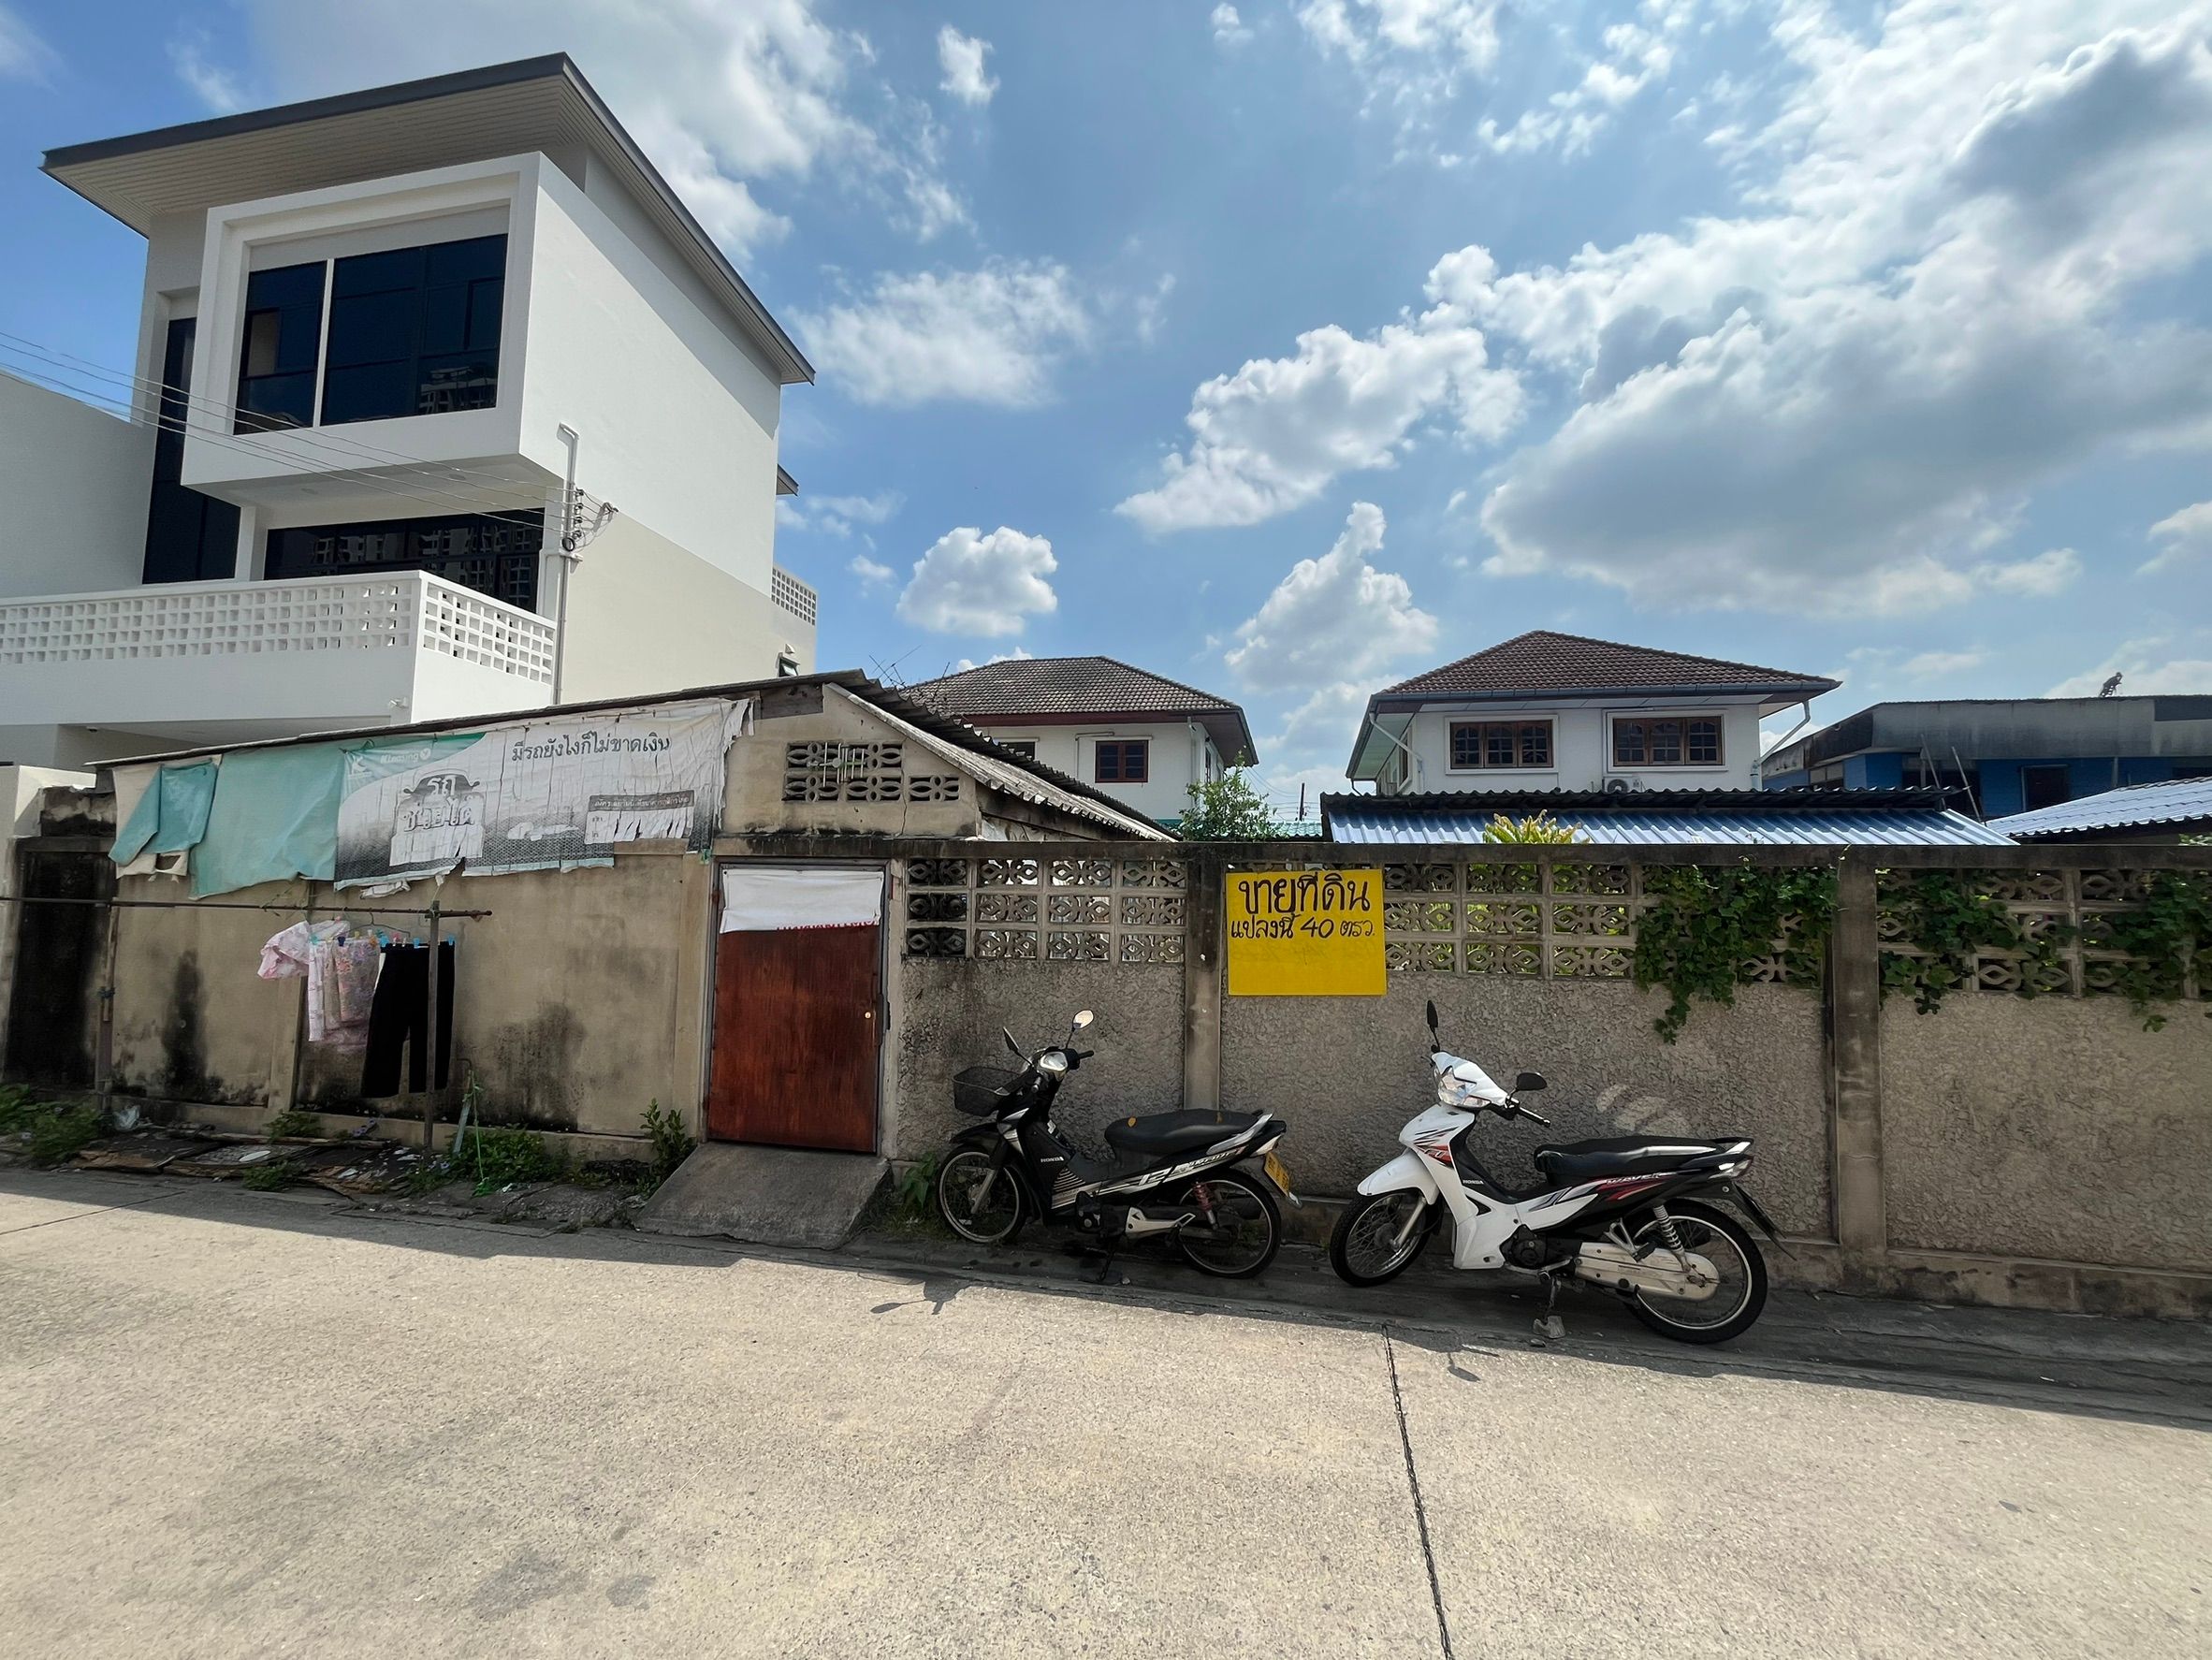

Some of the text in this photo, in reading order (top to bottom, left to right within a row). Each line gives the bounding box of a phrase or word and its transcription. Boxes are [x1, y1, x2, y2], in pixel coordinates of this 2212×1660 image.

[511, 730, 671, 761] มีรถยังไงก็ไม่ขาดเงิน
[427, 775, 457, 795] รถ
[1238, 871, 1371, 914] ขายที่ดิน
[1230, 911, 1302, 939] แปลงนี้
[1300, 916, 1334, 939] 40
